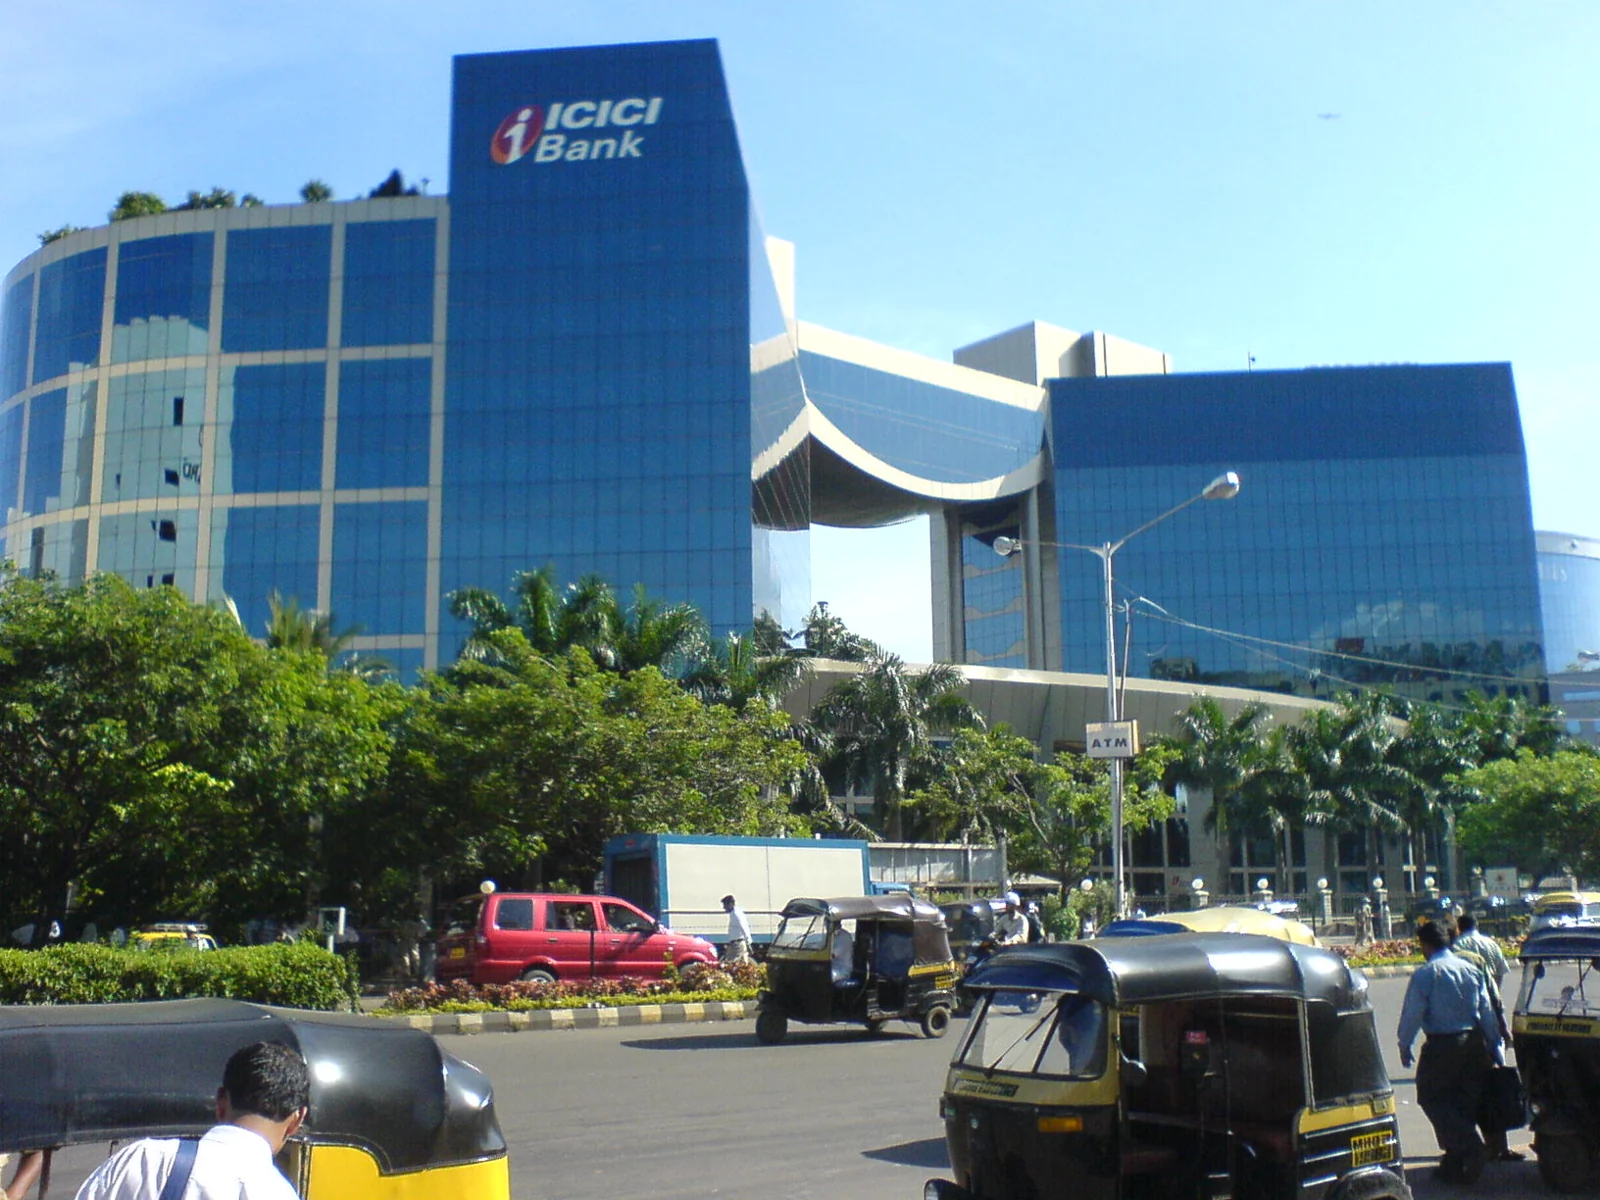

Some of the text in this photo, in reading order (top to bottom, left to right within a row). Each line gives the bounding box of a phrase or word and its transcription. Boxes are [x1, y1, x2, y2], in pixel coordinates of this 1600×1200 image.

[544, 97, 663, 131] ICICI
[533, 130, 644, 163] Bank
[1091, 737, 1128, 749] ATM
